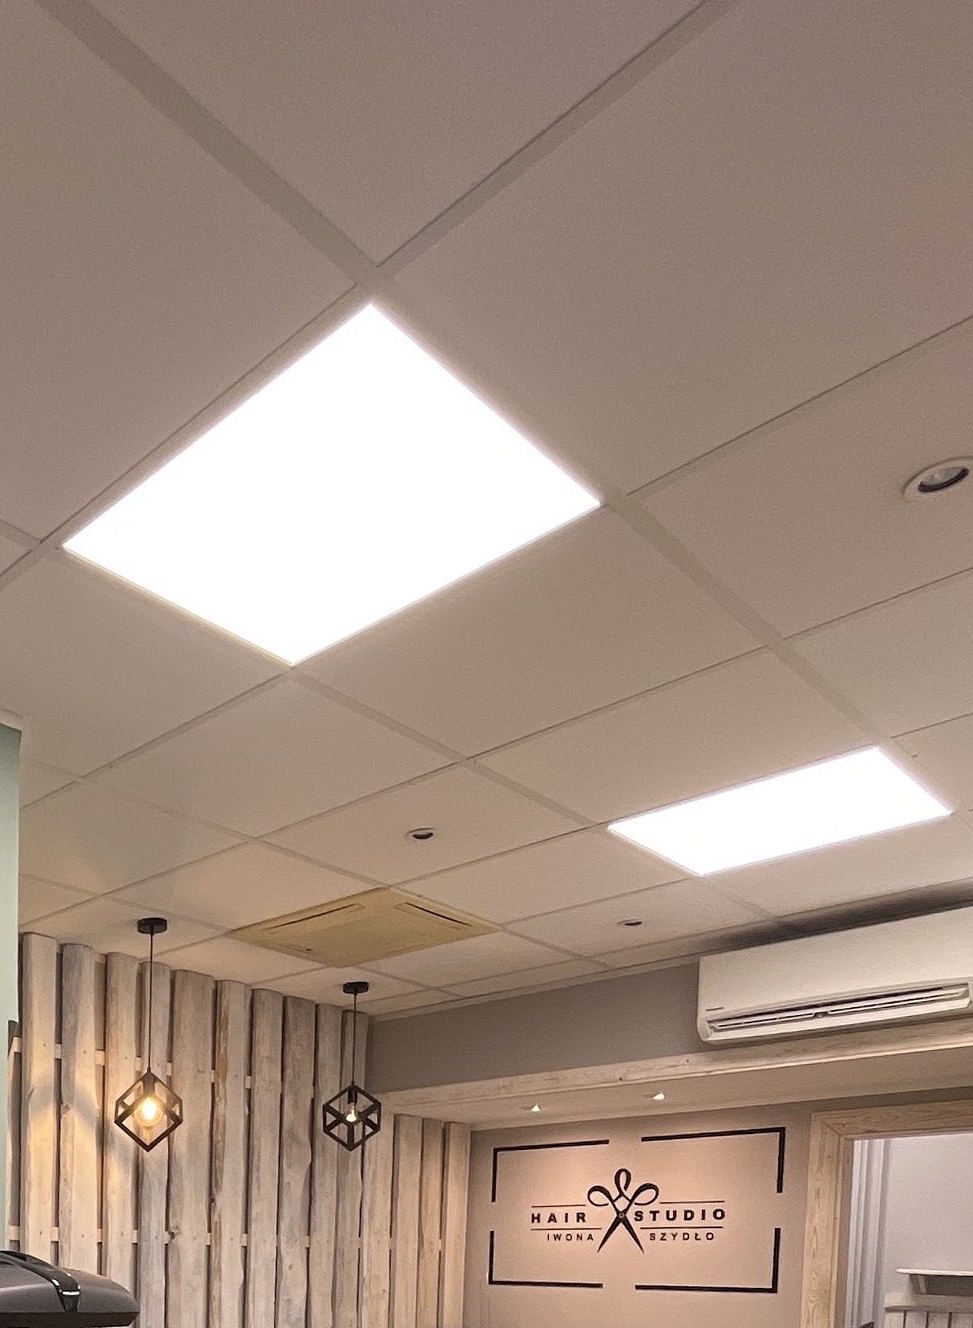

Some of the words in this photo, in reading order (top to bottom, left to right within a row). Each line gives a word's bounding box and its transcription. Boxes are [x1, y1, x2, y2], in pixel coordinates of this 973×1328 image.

[531, 1212, 586, 1224] HAIR
[634, 1208, 726, 1222] STUDIO
[547, 1233, 594, 1242] IWONA
[649, 1232, 715, 1242] SZYDŁO
